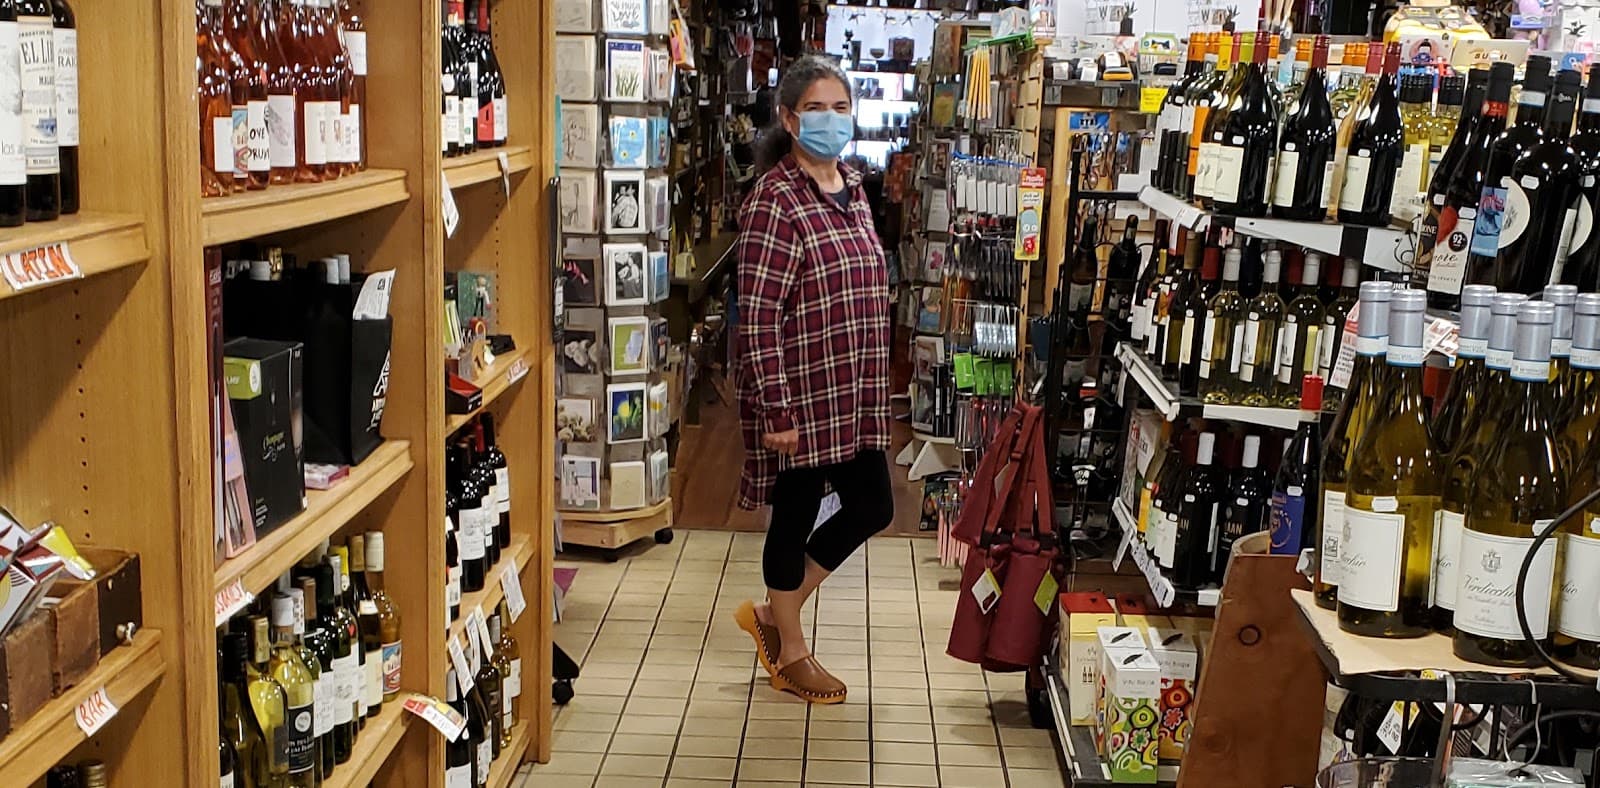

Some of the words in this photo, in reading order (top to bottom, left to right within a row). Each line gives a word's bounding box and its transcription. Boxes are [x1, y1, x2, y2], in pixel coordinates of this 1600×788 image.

[1474, 52, 1508, 61] SUHI
[5, 243, 74, 284] LATIN
[1463, 574, 1517, 598] Verdicchi
[79, 690, 109, 728] BAR
